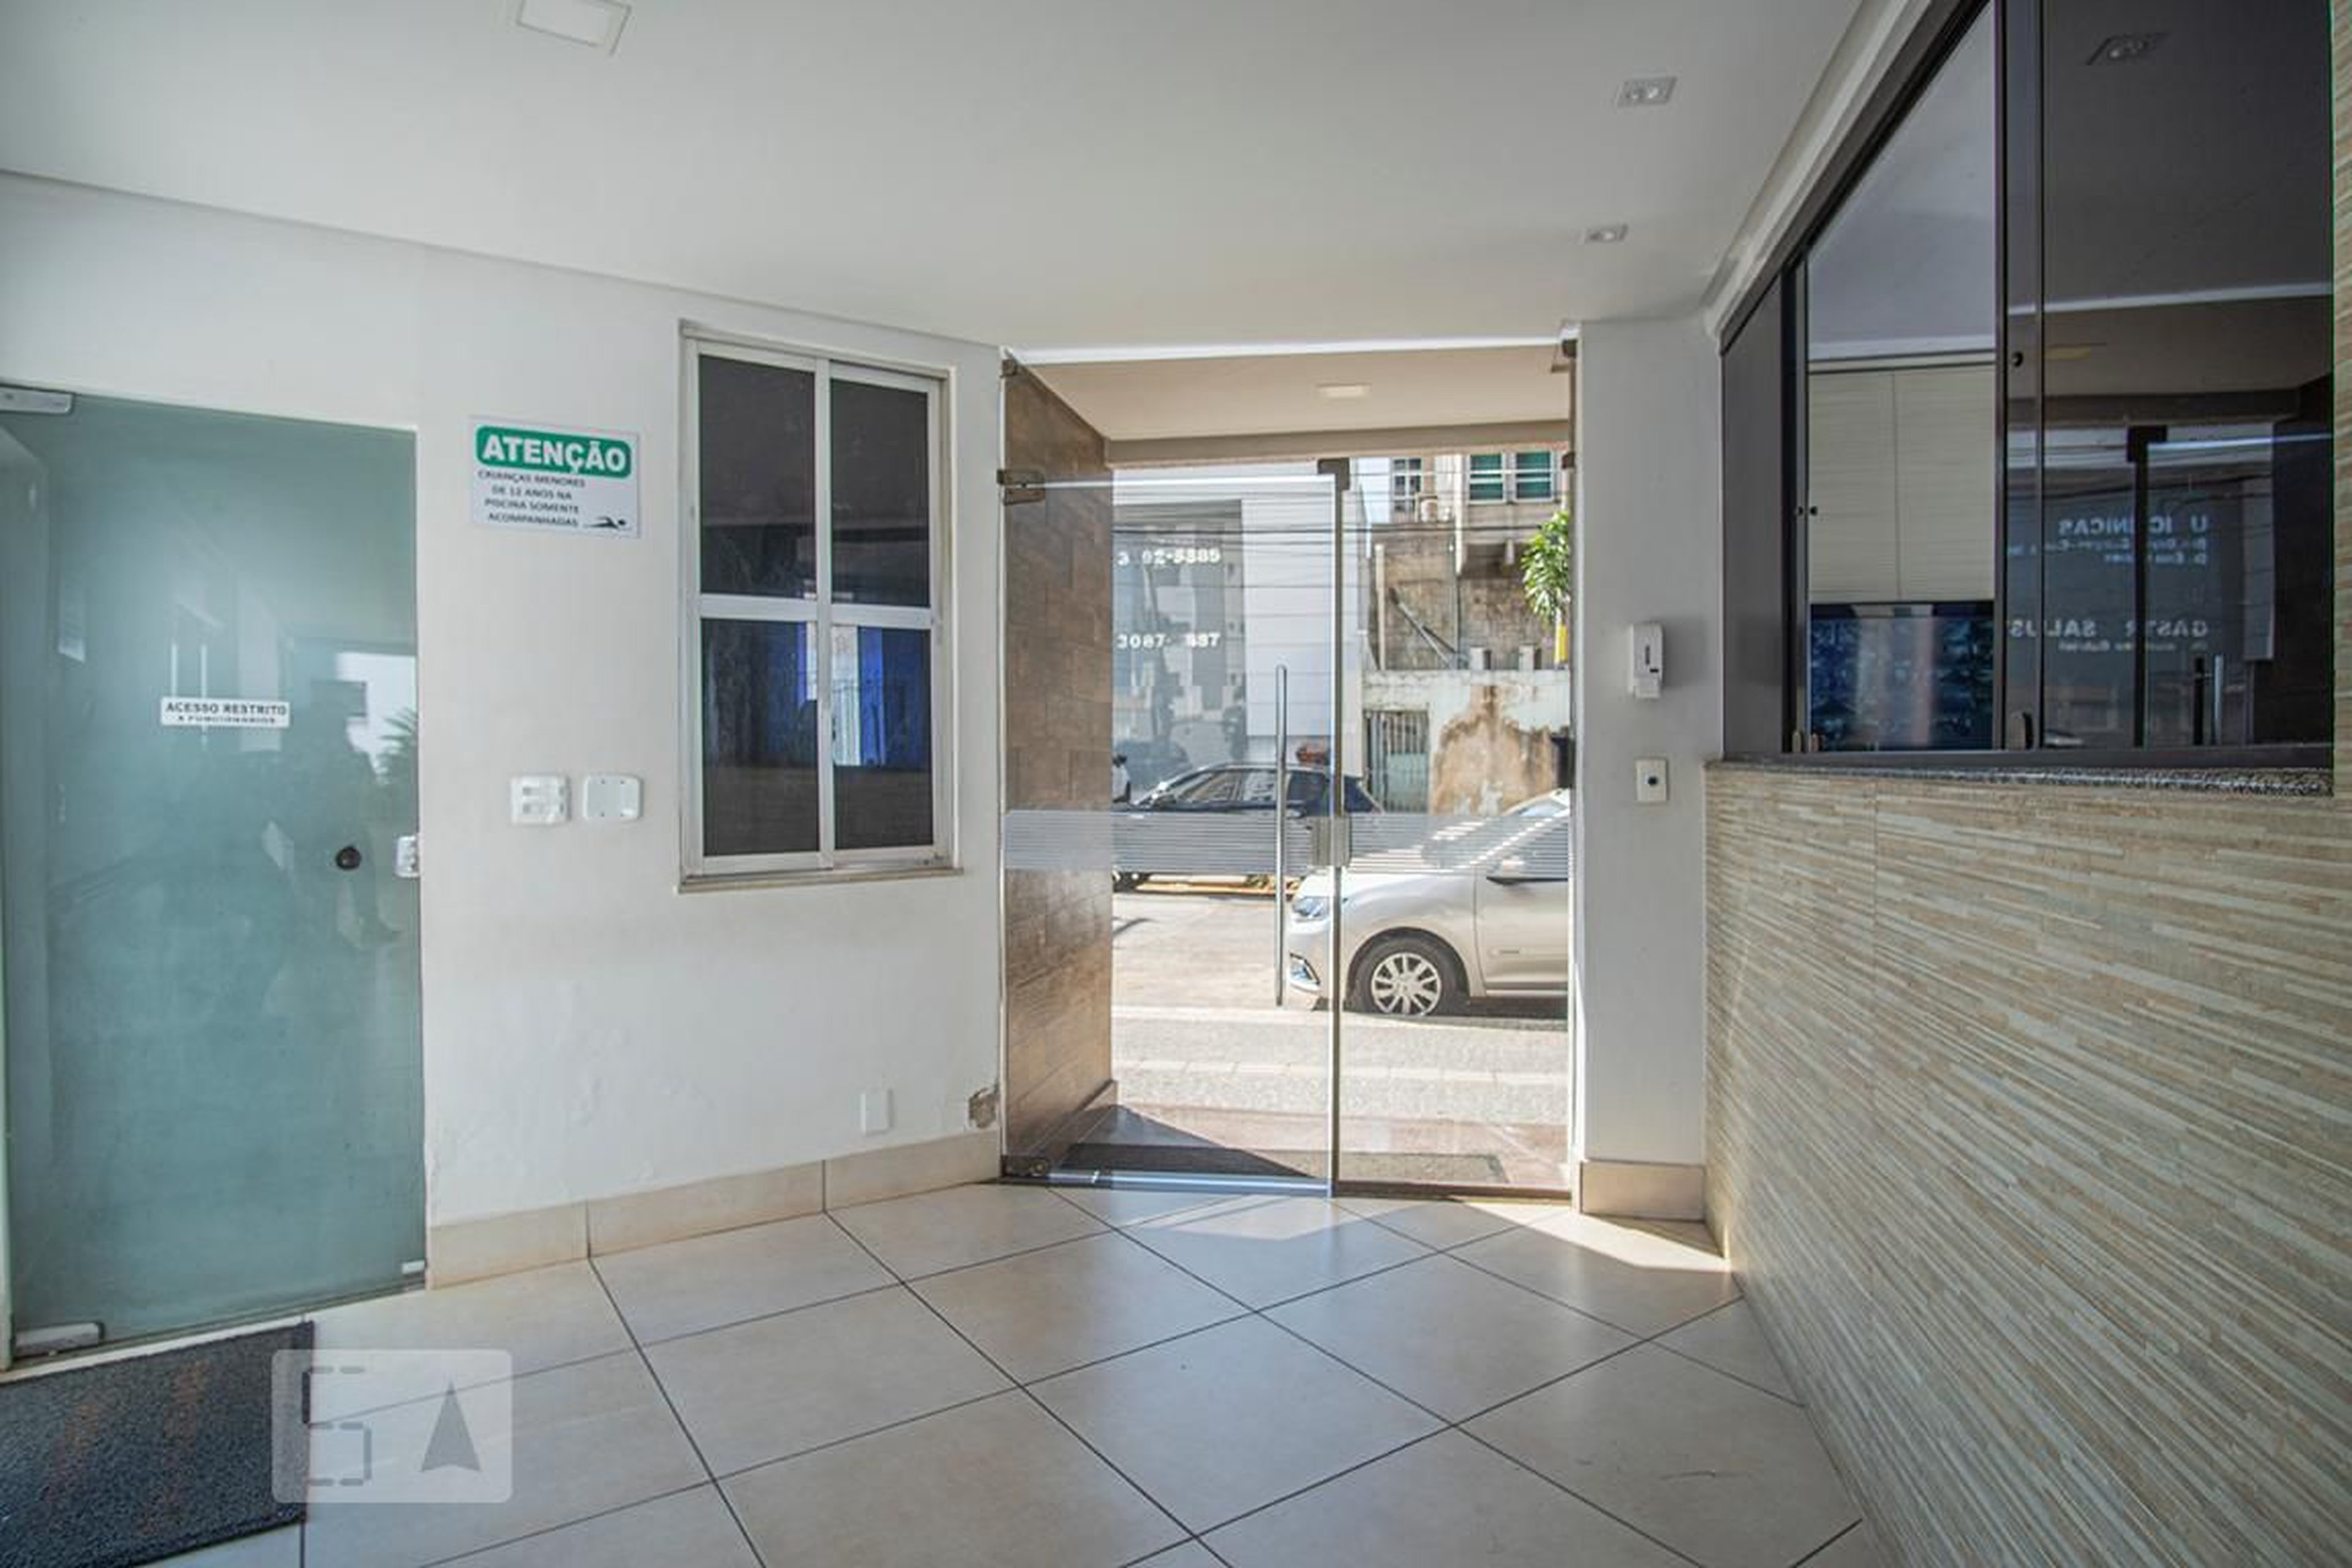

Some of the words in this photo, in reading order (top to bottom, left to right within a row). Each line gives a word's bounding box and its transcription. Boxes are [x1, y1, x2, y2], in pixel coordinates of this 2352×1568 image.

[481, 434, 626, 475] ATENÇÃO
[478, 470, 532, 484] CRIANÇAS
[535, 472, 586, 488] MENORES
[492, 486, 506, 496] DE
[510, 486, 521, 496] 12
[525, 488, 554, 498] ANOS
[557, 490, 573, 500] NA
[484, 499, 527, 510] PISCINA
[530, 500, 579, 514] SOMENTE
[488, 513, 579, 527] ACOMPANHADAS
[165, 702, 219, 714] ACESSO
[223, 703, 287, 716] RESTRITO
